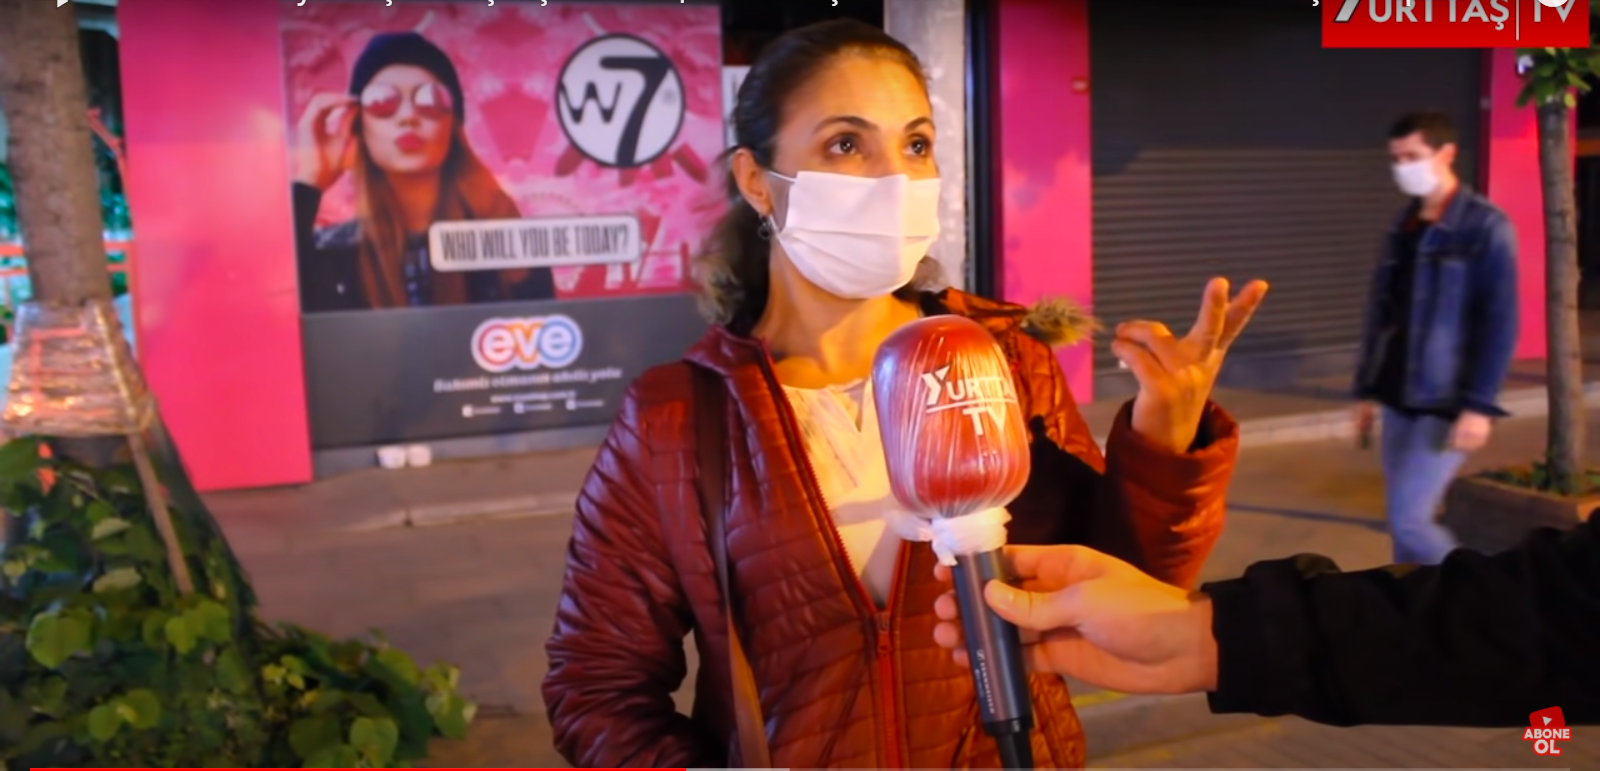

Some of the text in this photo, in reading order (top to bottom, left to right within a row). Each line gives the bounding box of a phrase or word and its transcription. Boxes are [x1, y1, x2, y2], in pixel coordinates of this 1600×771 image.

[441, 223, 629, 261] WHO WILL YOU BE TODAY?
[474, 316, 581, 371] eve
[963, 405, 1006, 435] TV
